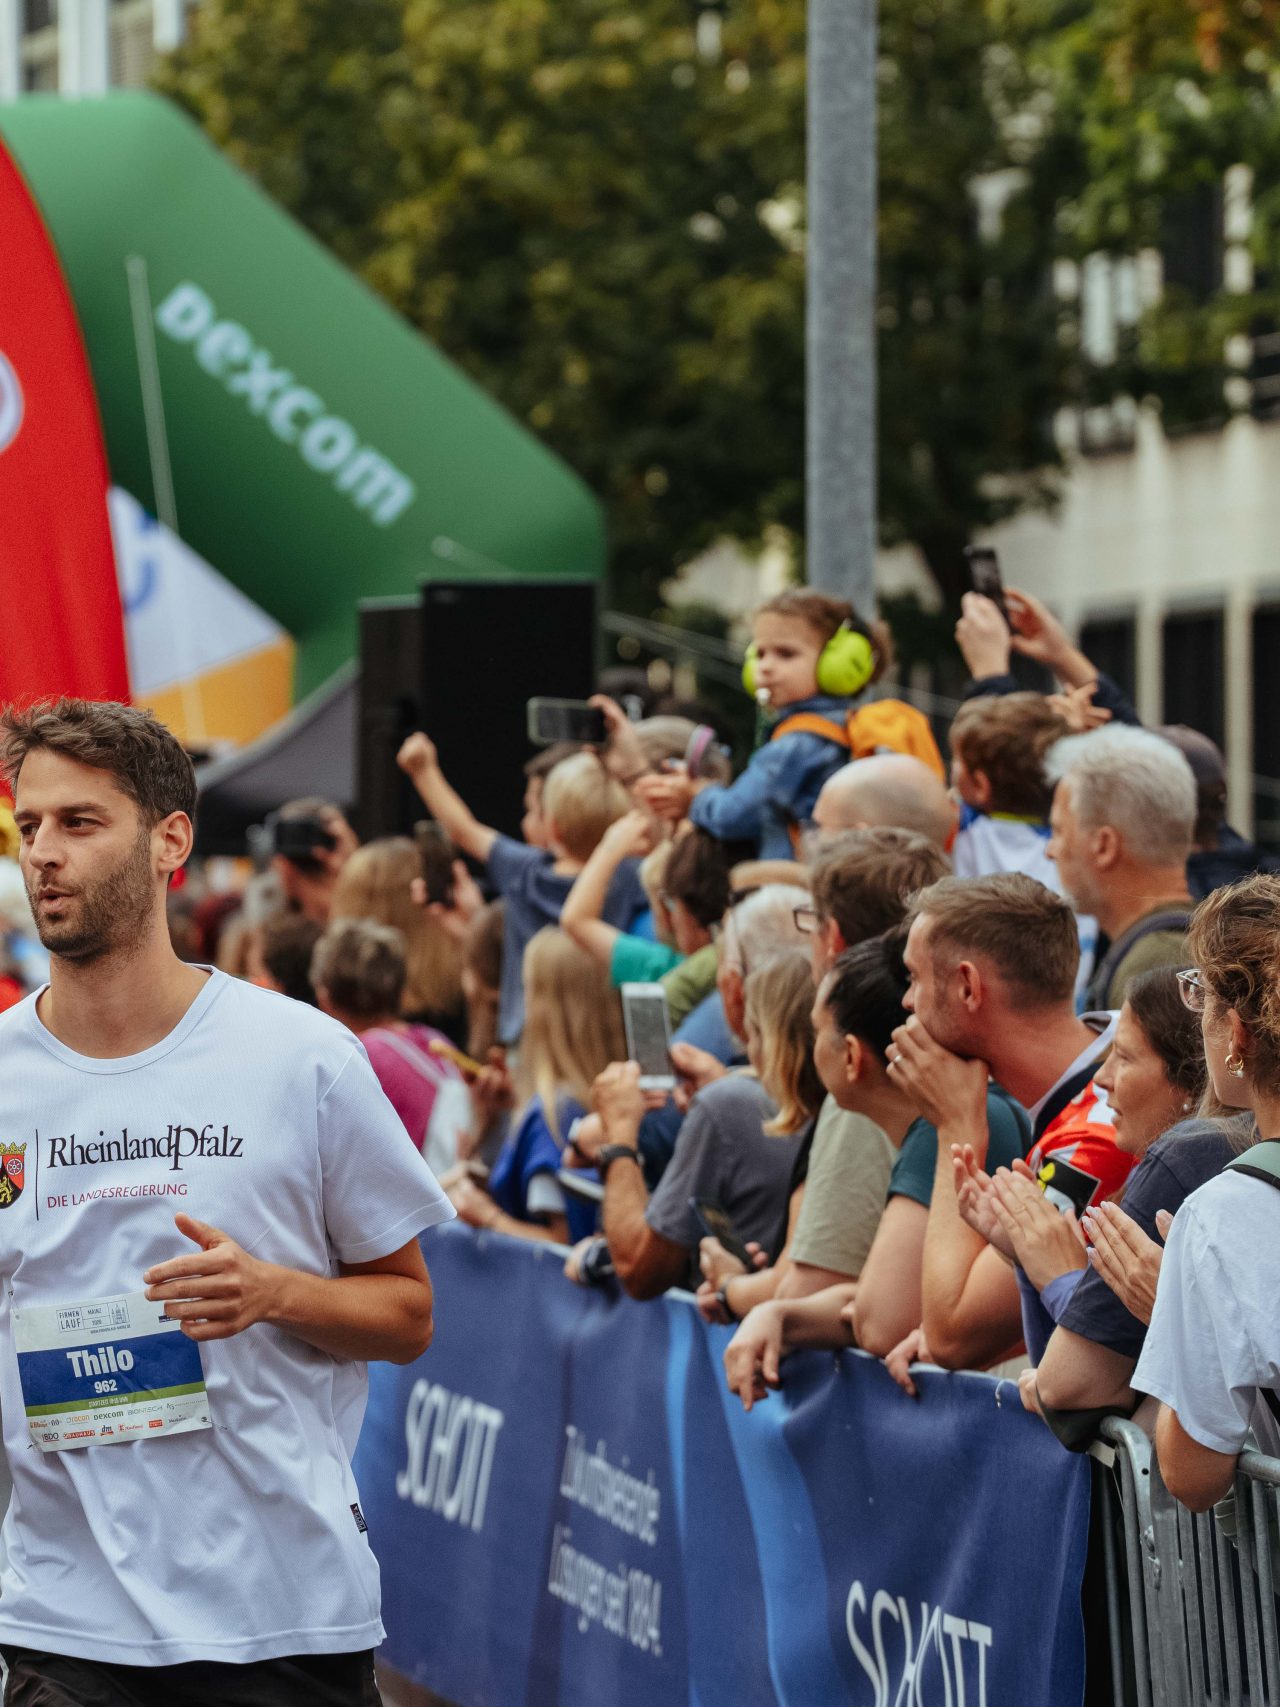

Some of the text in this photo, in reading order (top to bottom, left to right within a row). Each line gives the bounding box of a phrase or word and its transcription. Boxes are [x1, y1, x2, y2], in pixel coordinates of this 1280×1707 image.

[47, 1183, 188, 1209] DIE LANDESREGIERUNG
[58, 1310, 81, 1319] FIRMEN
[60, 1318, 81, 1330] LAUF
[65, 1346, 134, 1378] Thilo
[94, 1379, 118, 1394] 962
[395, 1377, 504, 1534] SCHOTT
